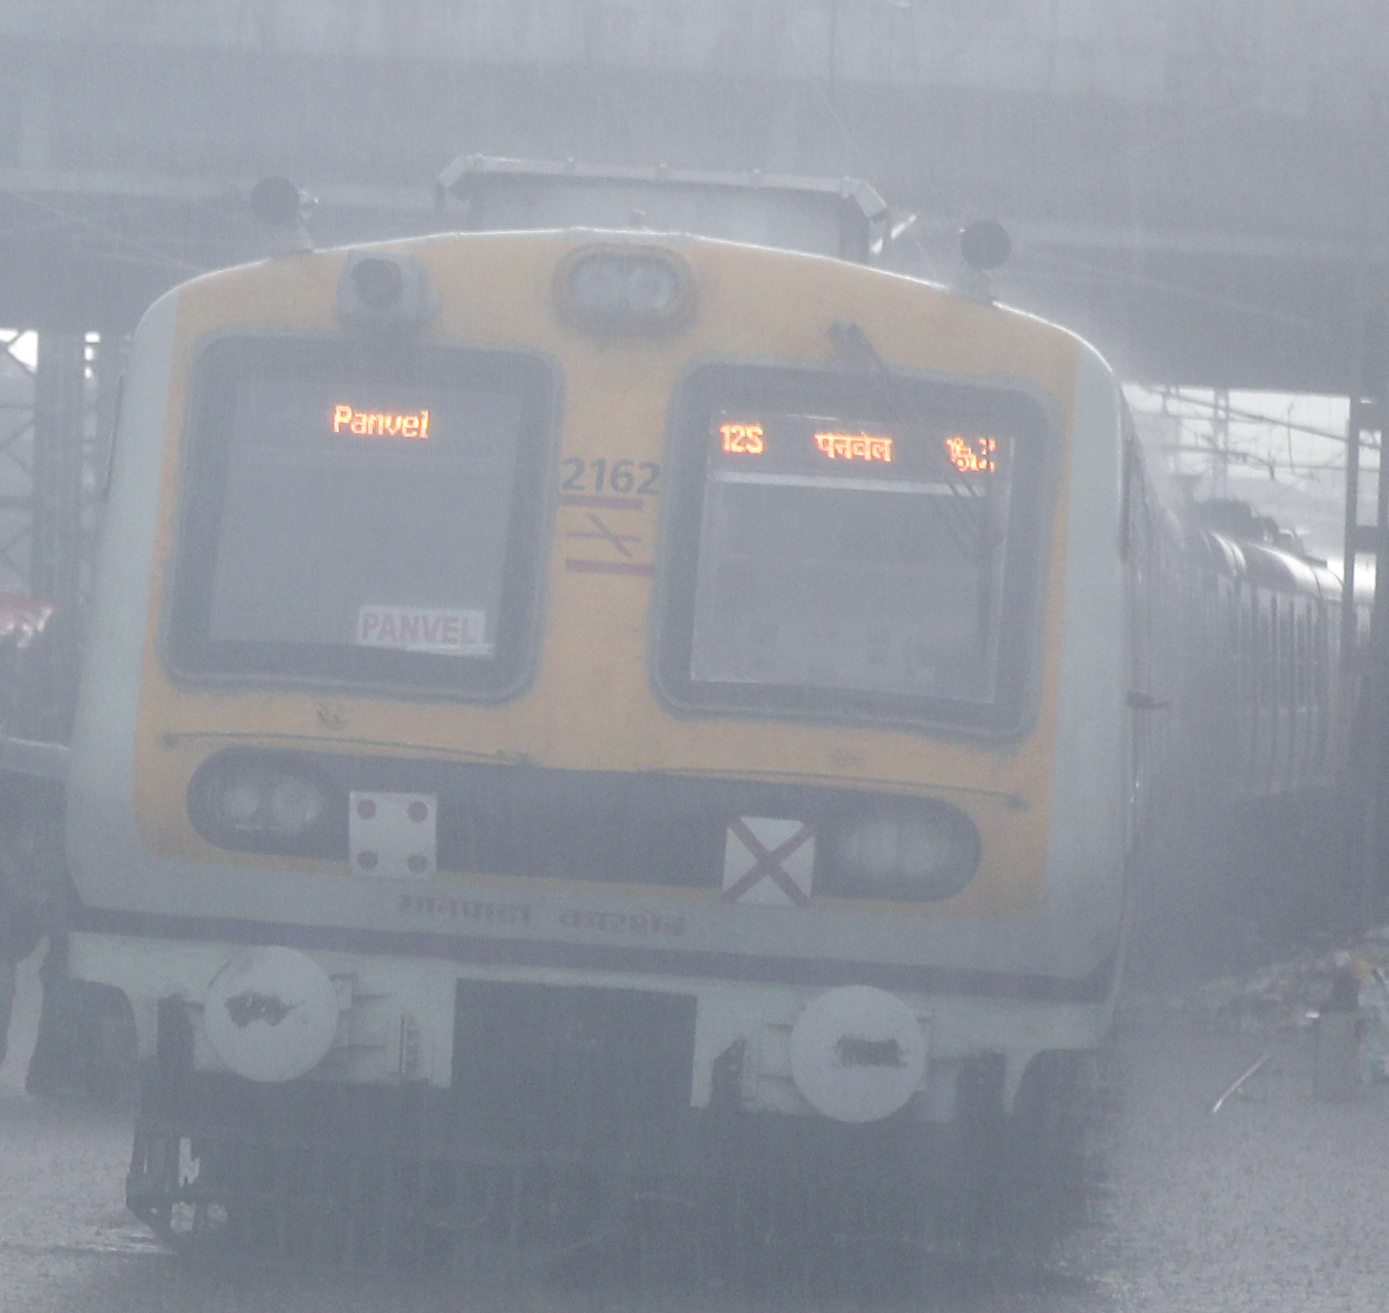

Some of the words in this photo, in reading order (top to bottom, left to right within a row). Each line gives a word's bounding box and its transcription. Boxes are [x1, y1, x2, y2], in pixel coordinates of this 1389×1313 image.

[333, 404, 429, 439] Panvel
[814, 431, 893, 462] पनवेल
[561, 457, 661, 495] 2162
[361, 612, 477, 645] PANVEL
